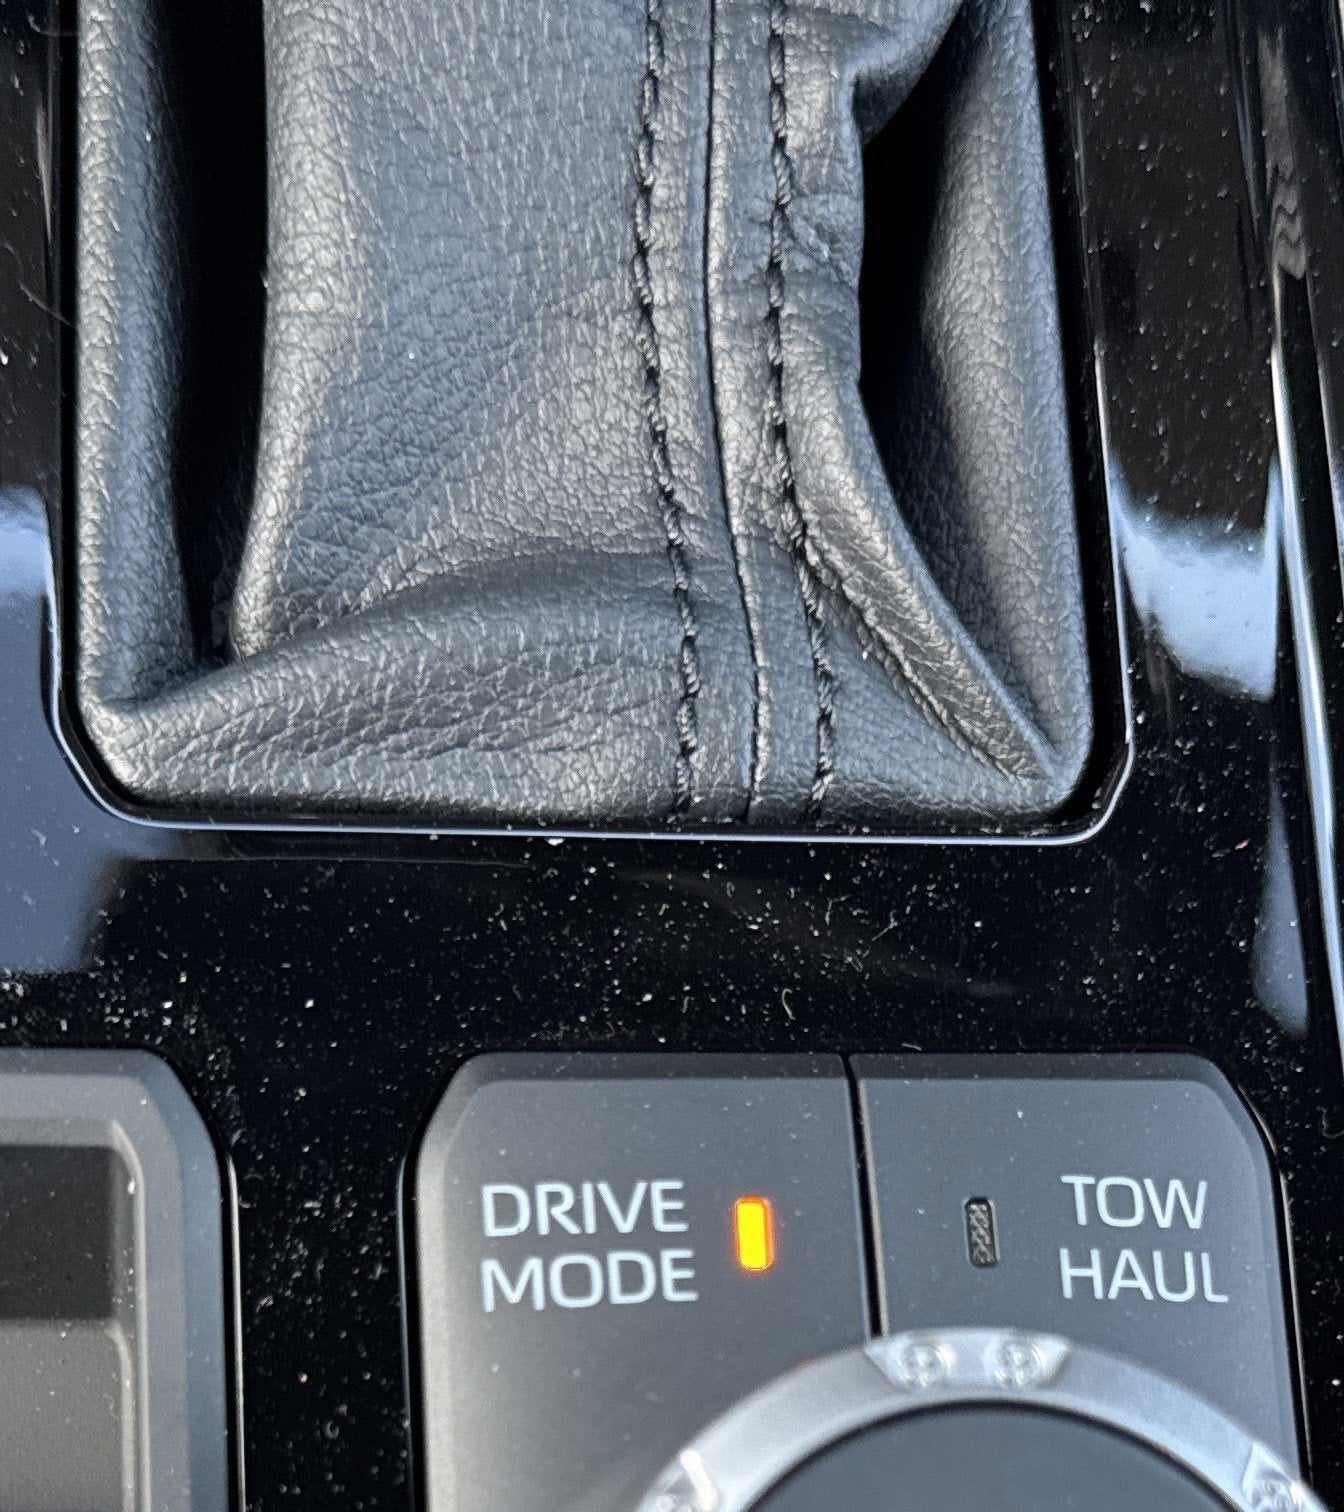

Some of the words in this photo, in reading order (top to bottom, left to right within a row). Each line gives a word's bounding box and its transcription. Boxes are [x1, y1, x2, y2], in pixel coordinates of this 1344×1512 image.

[480, 1178, 691, 1240] DRIVE
[1060, 1174, 1209, 1230] TOW
[481, 1248, 700, 1313] MODE
[1060, 1246, 1231, 1304] HAUL
